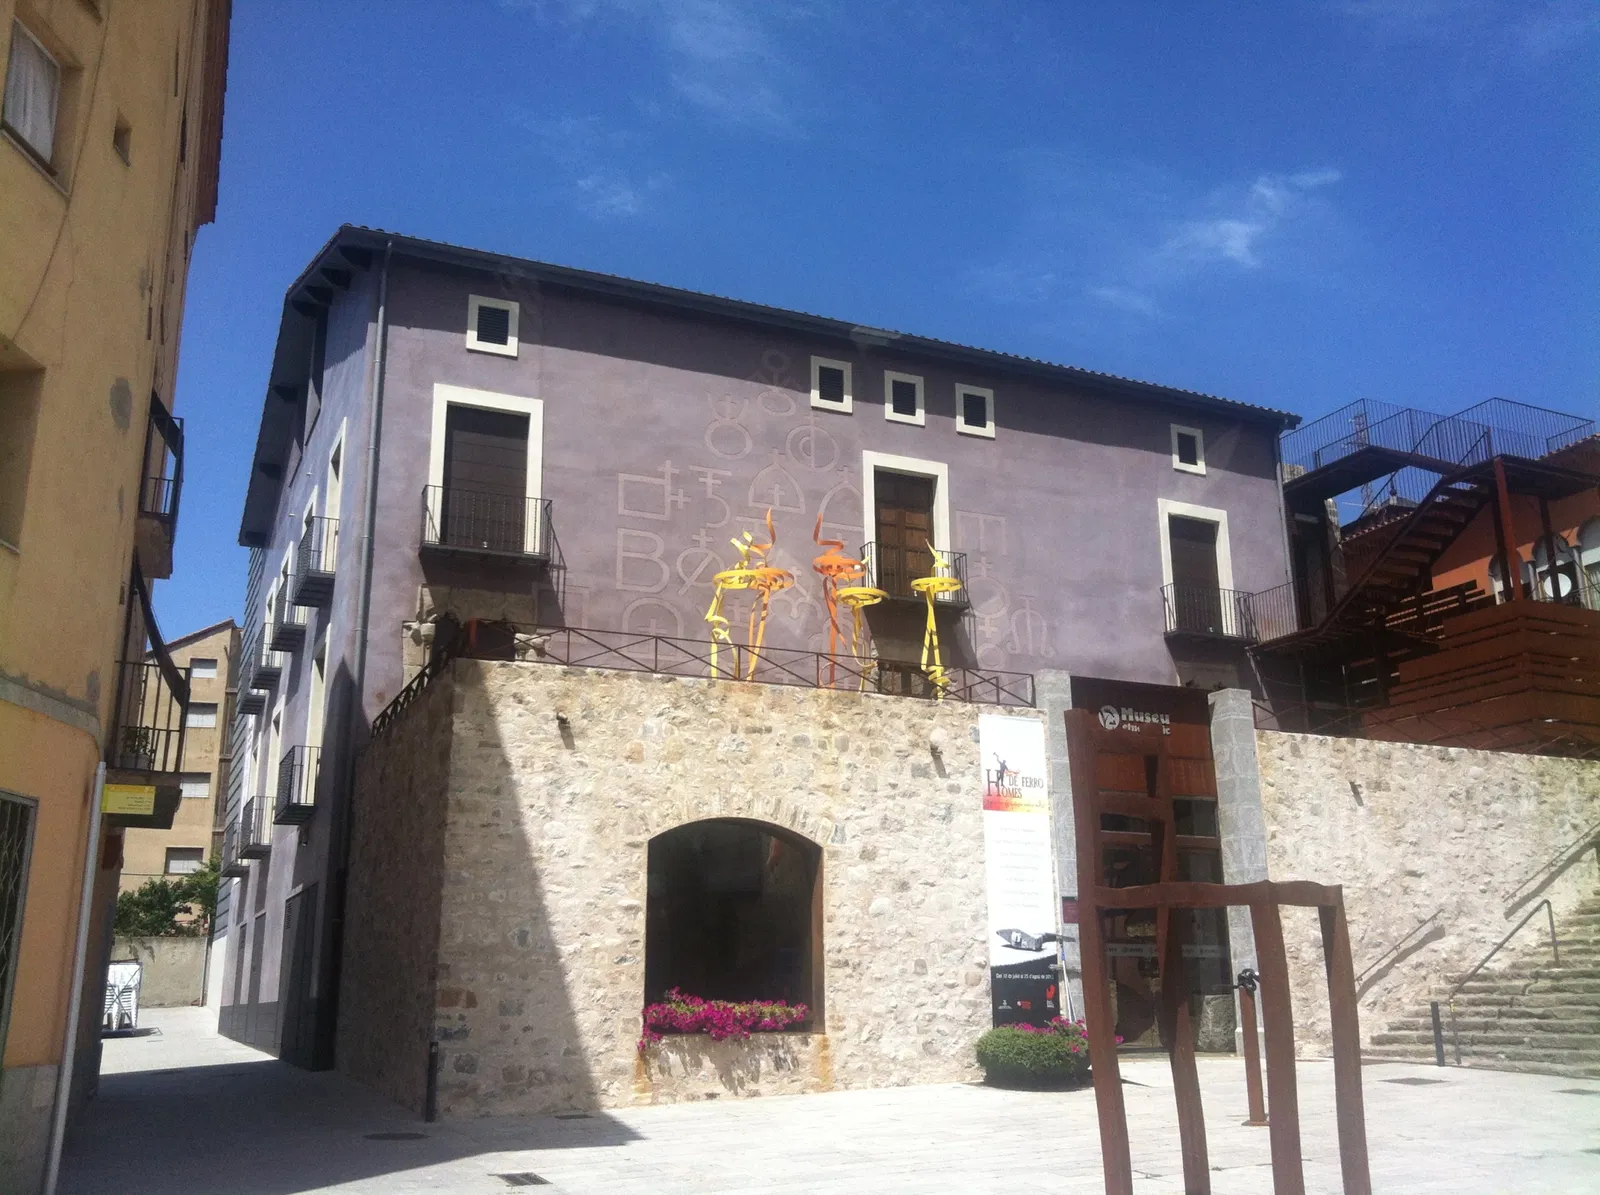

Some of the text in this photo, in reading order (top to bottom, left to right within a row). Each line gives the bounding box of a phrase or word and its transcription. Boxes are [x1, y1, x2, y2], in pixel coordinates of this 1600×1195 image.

[1120, 707, 1170, 725] Museu
[1008, 775, 1044, 789] DE FERRO
